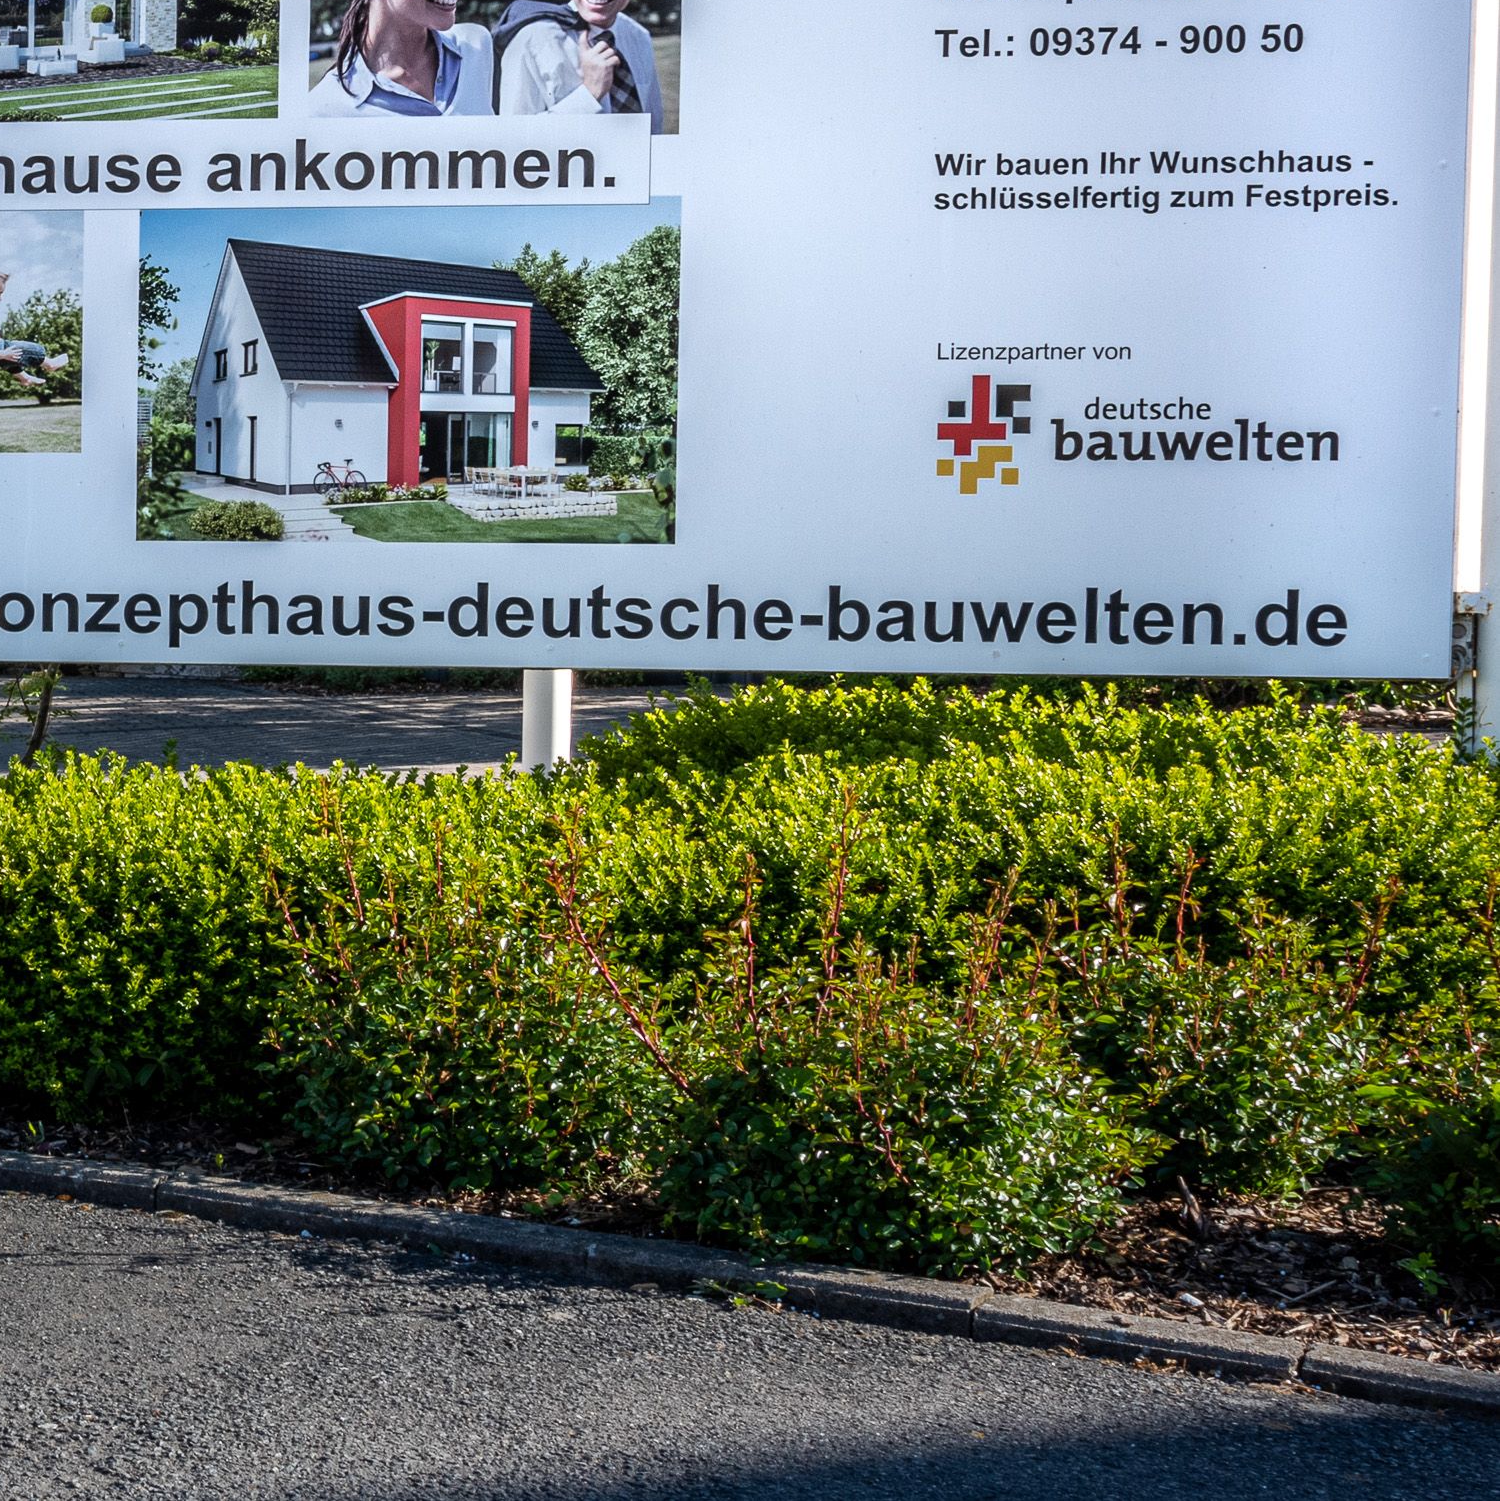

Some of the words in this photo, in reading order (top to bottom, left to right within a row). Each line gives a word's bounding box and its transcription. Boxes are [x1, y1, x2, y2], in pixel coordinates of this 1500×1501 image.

[934, 28, 1015, 58] Tel.:
[1028, 25, 1143, 57] 09374
[1178, 24, 1247, 54] 900
[1259, 23, 1305, 53] 50
[205, 137, 617, 194] ankommen.
[934, 152, 988, 177] Wir
[995, 152, 1089, 177] bauen
[1099, 150, 1142, 176] Ihr
[1148, 148, 1353, 175] Wunschhaus
[933, 185, 1161, 215] schlüsselfertig
[1169, 189, 1235, 209] zum
[1245, 182, 1400, 214] Festpreis.
[936, 342, 1086, 365] Lizenzpartner
[1091, 345, 1132, 361] von
[1083, 396, 1213, 422] deutsche
[1050, 418, 1340, 463] bauwelten
